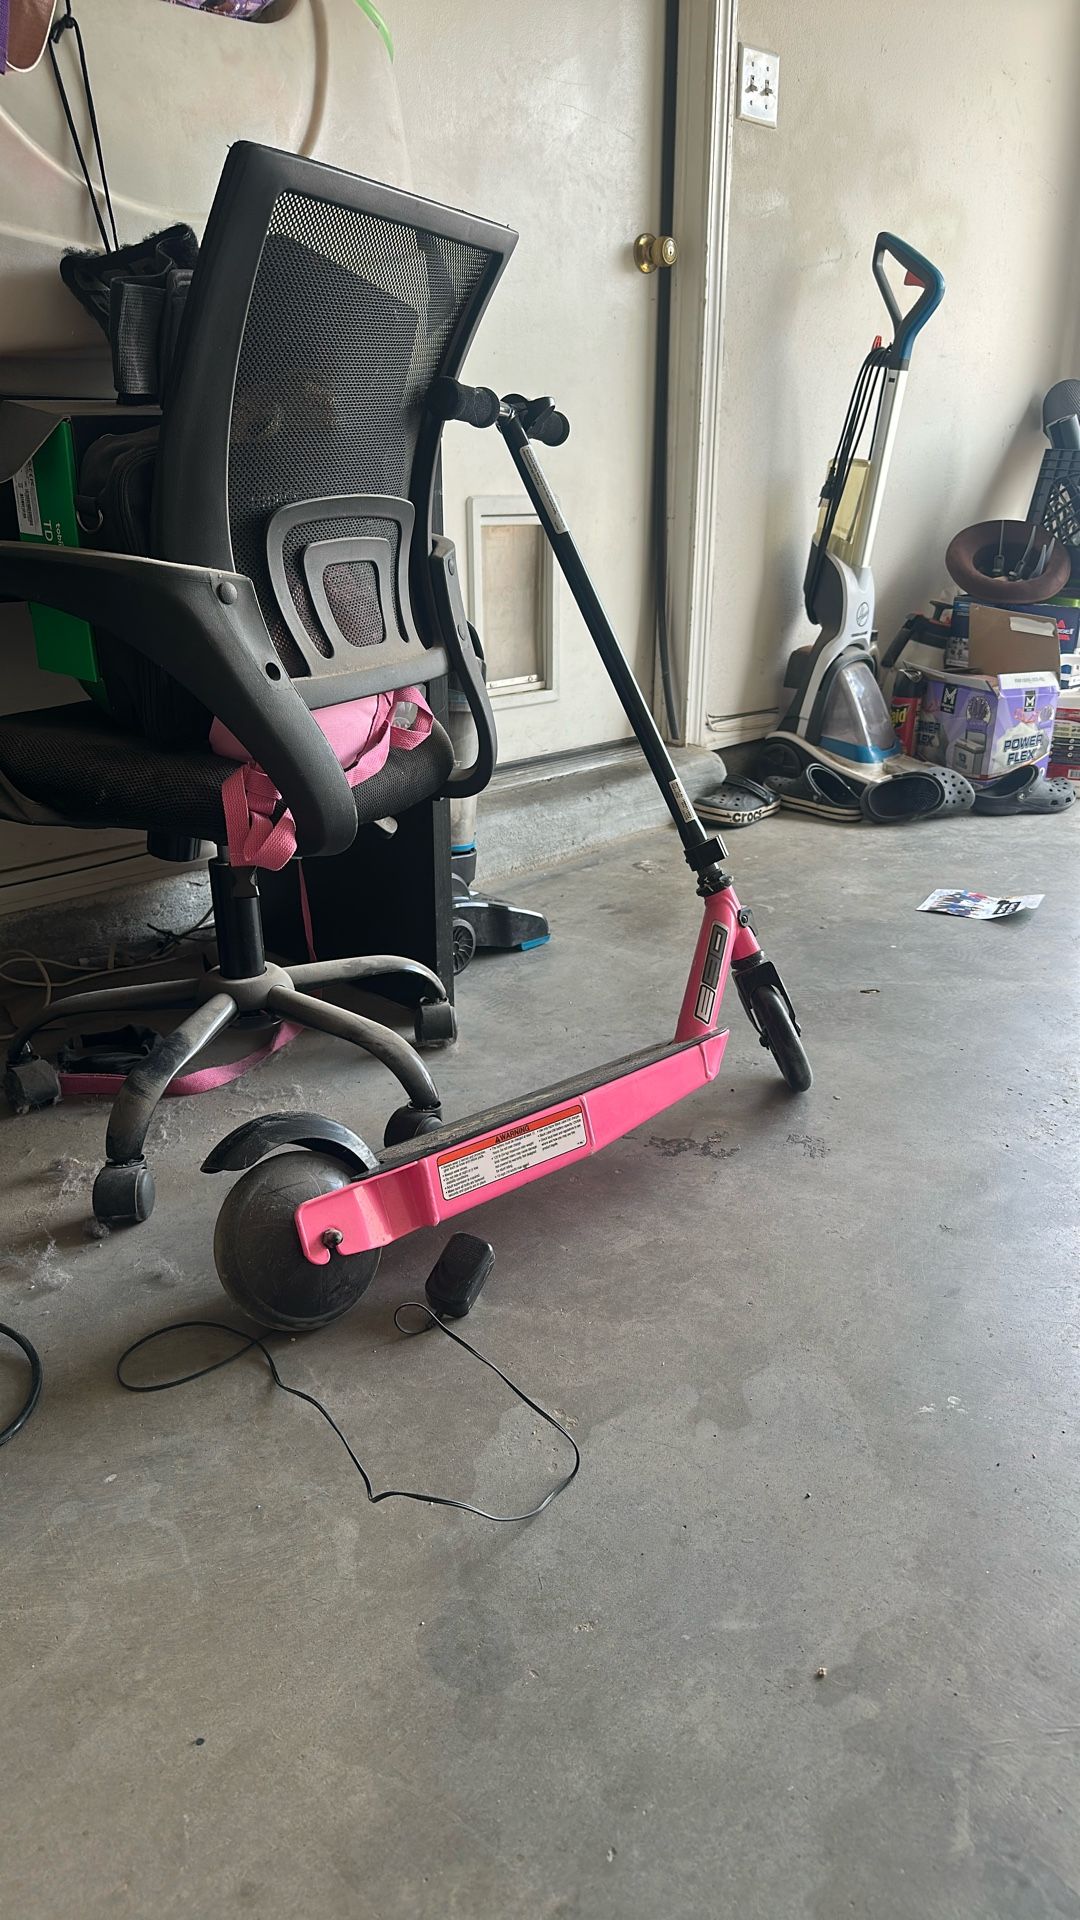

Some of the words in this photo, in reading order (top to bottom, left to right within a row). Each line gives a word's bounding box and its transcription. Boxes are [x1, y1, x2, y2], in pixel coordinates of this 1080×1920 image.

[43, 520, 54, 541] TD
[1004, 735, 1043, 752] POWER
[1007, 749, 1034, 766] FLEX
[732, 810, 762, 822] crocs
[499, 1126, 530, 1141] WARNING
